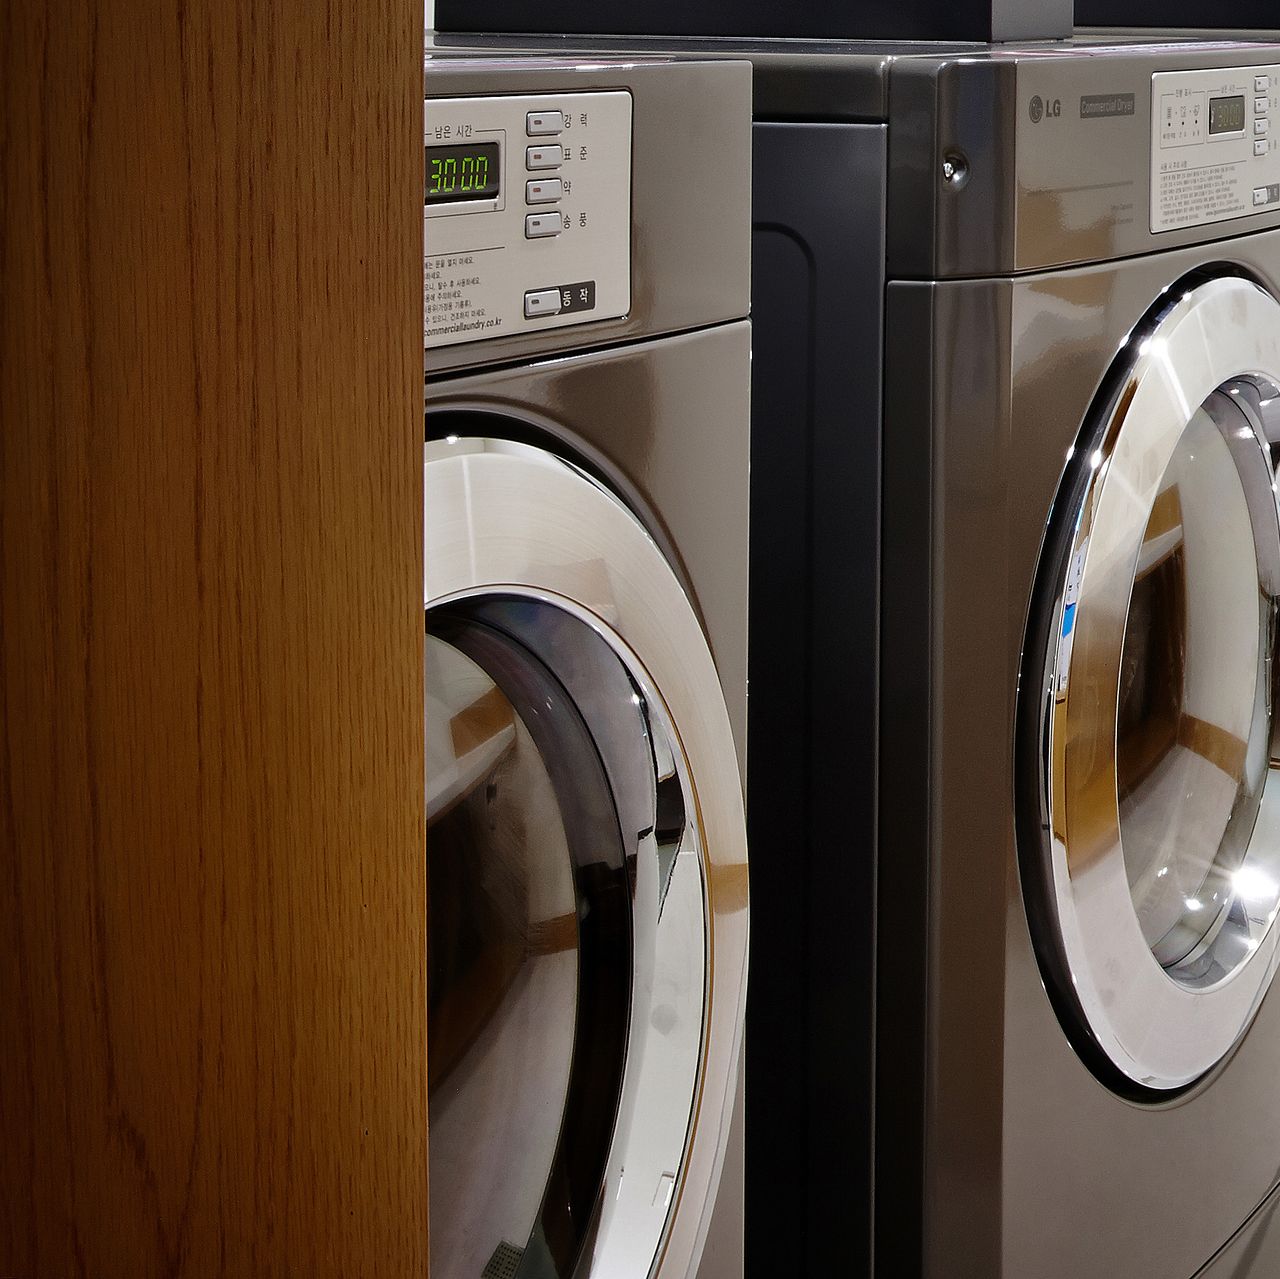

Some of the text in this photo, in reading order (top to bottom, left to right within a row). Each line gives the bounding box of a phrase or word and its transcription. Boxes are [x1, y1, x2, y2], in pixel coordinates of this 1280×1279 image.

[1045, 99, 1061, 118] LG
[1081, 98, 1133, 114] Commercial Dryer
[434, 125, 473, 139] 남은 시간
